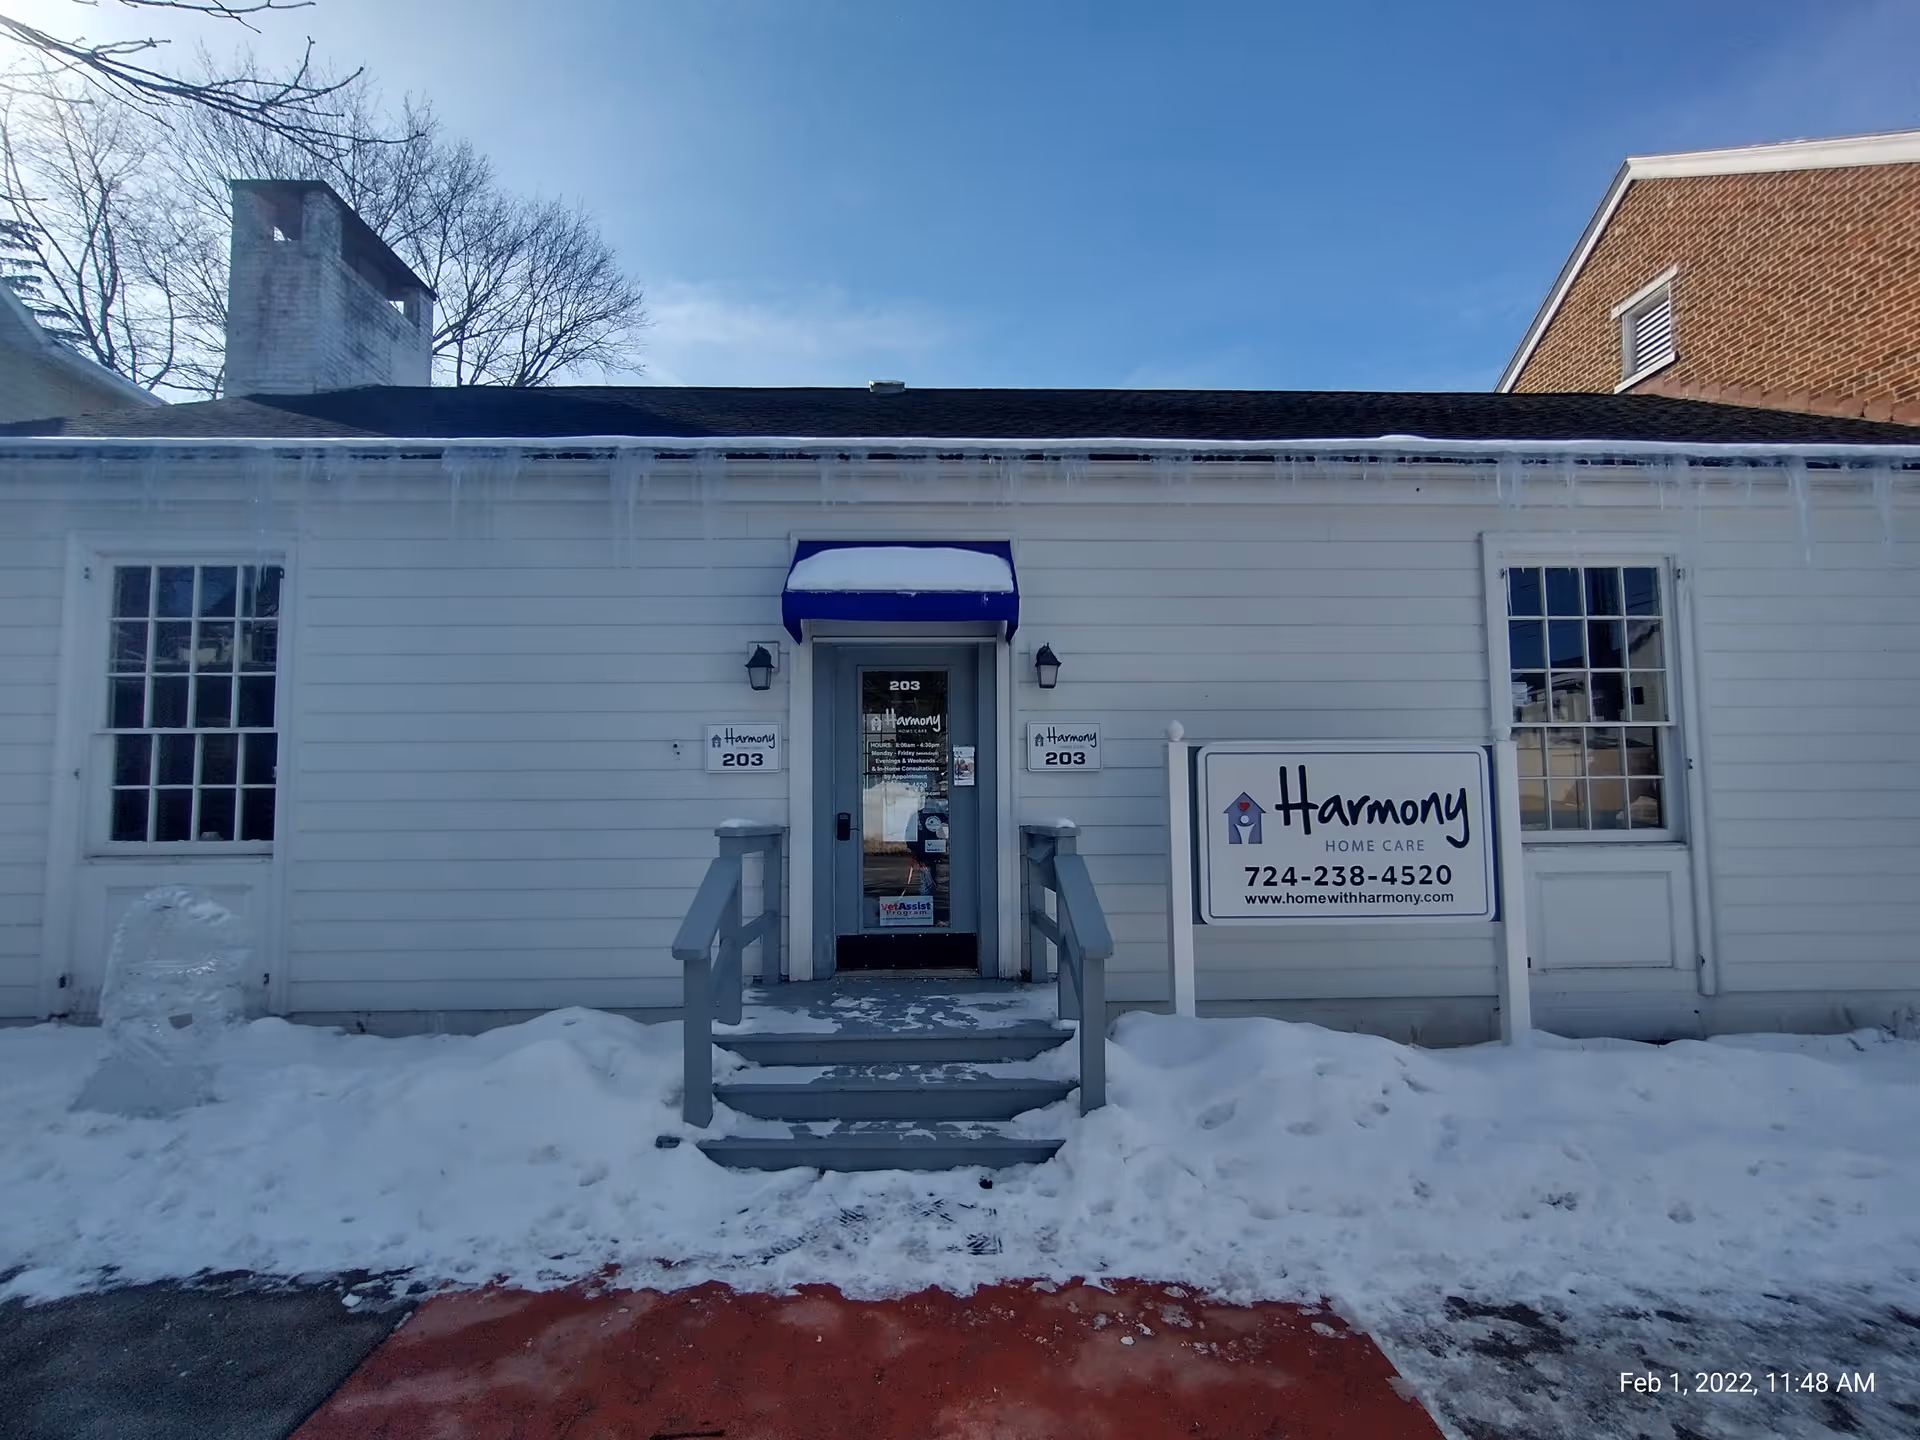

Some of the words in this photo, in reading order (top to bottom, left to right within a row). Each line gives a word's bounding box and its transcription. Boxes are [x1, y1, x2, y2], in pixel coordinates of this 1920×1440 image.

[889, 680, 921, 691] 203
[885, 707, 941, 732] Harmony
[724, 728, 776, 749] Harmony
[1046, 726, 1097, 748] Harmony
[722, 753, 764, 766] 203
[1045, 752, 1086, 765] 203
[1275, 764, 1470, 848] Harmony
[1325, 840, 1375, 852] HOME
[1382, 840, 1425, 851] CARE
[1244, 865, 1452, 886] 724-238-4520
[1244, 892, 1454, 905] www.homewithharmony.com
